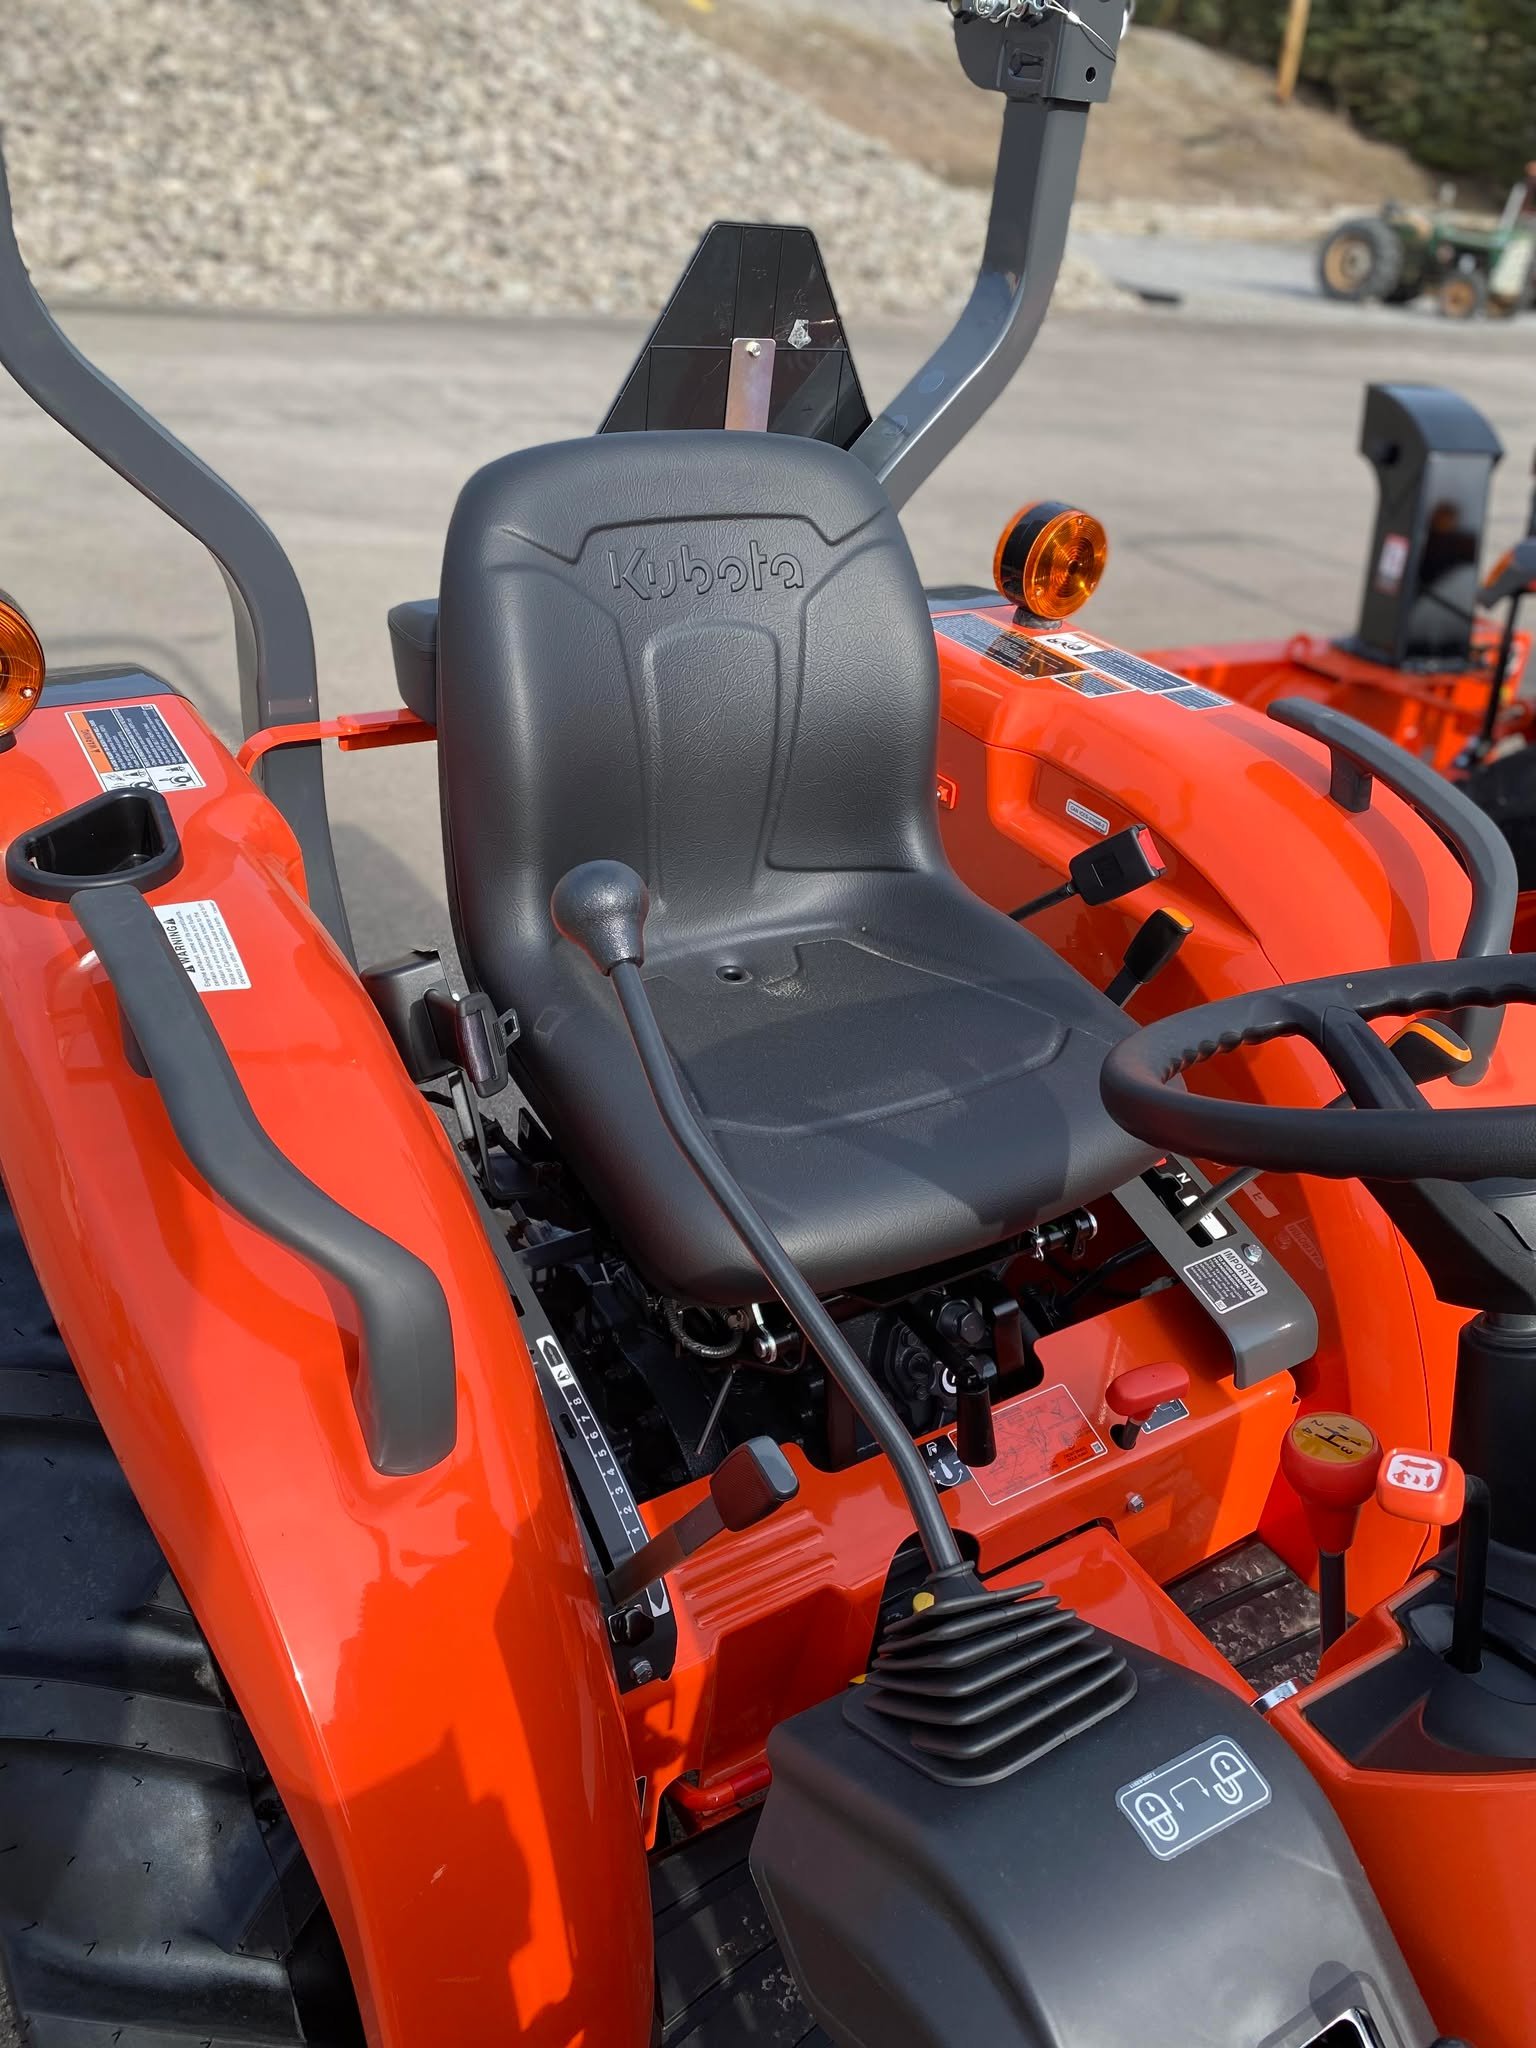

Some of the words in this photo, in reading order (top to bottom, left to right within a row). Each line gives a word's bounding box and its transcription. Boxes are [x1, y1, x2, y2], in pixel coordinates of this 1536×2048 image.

[608, 540, 804, 600] Kubota
[81, 728, 97, 749] WARNING
[1070, 805, 1078, 813] CAN
[166, 925, 192, 964] WARNING
[1177, 1172, 1191, 1184] N
[1223, 1250, 1265, 1293] IMPORTANT
[573, 1398, 582, 1406] 8
[1311, 1419, 1324, 1427] 2
[590, 1431, 599, 1439] 6
[598, 1449, 607, 1457] 5
[1341, 1446, 1353, 1455] 3
[607, 1468, 615, 1476] 4
[615, 1487, 624, 1495] 3
[624, 1505, 633, 1514] 2
